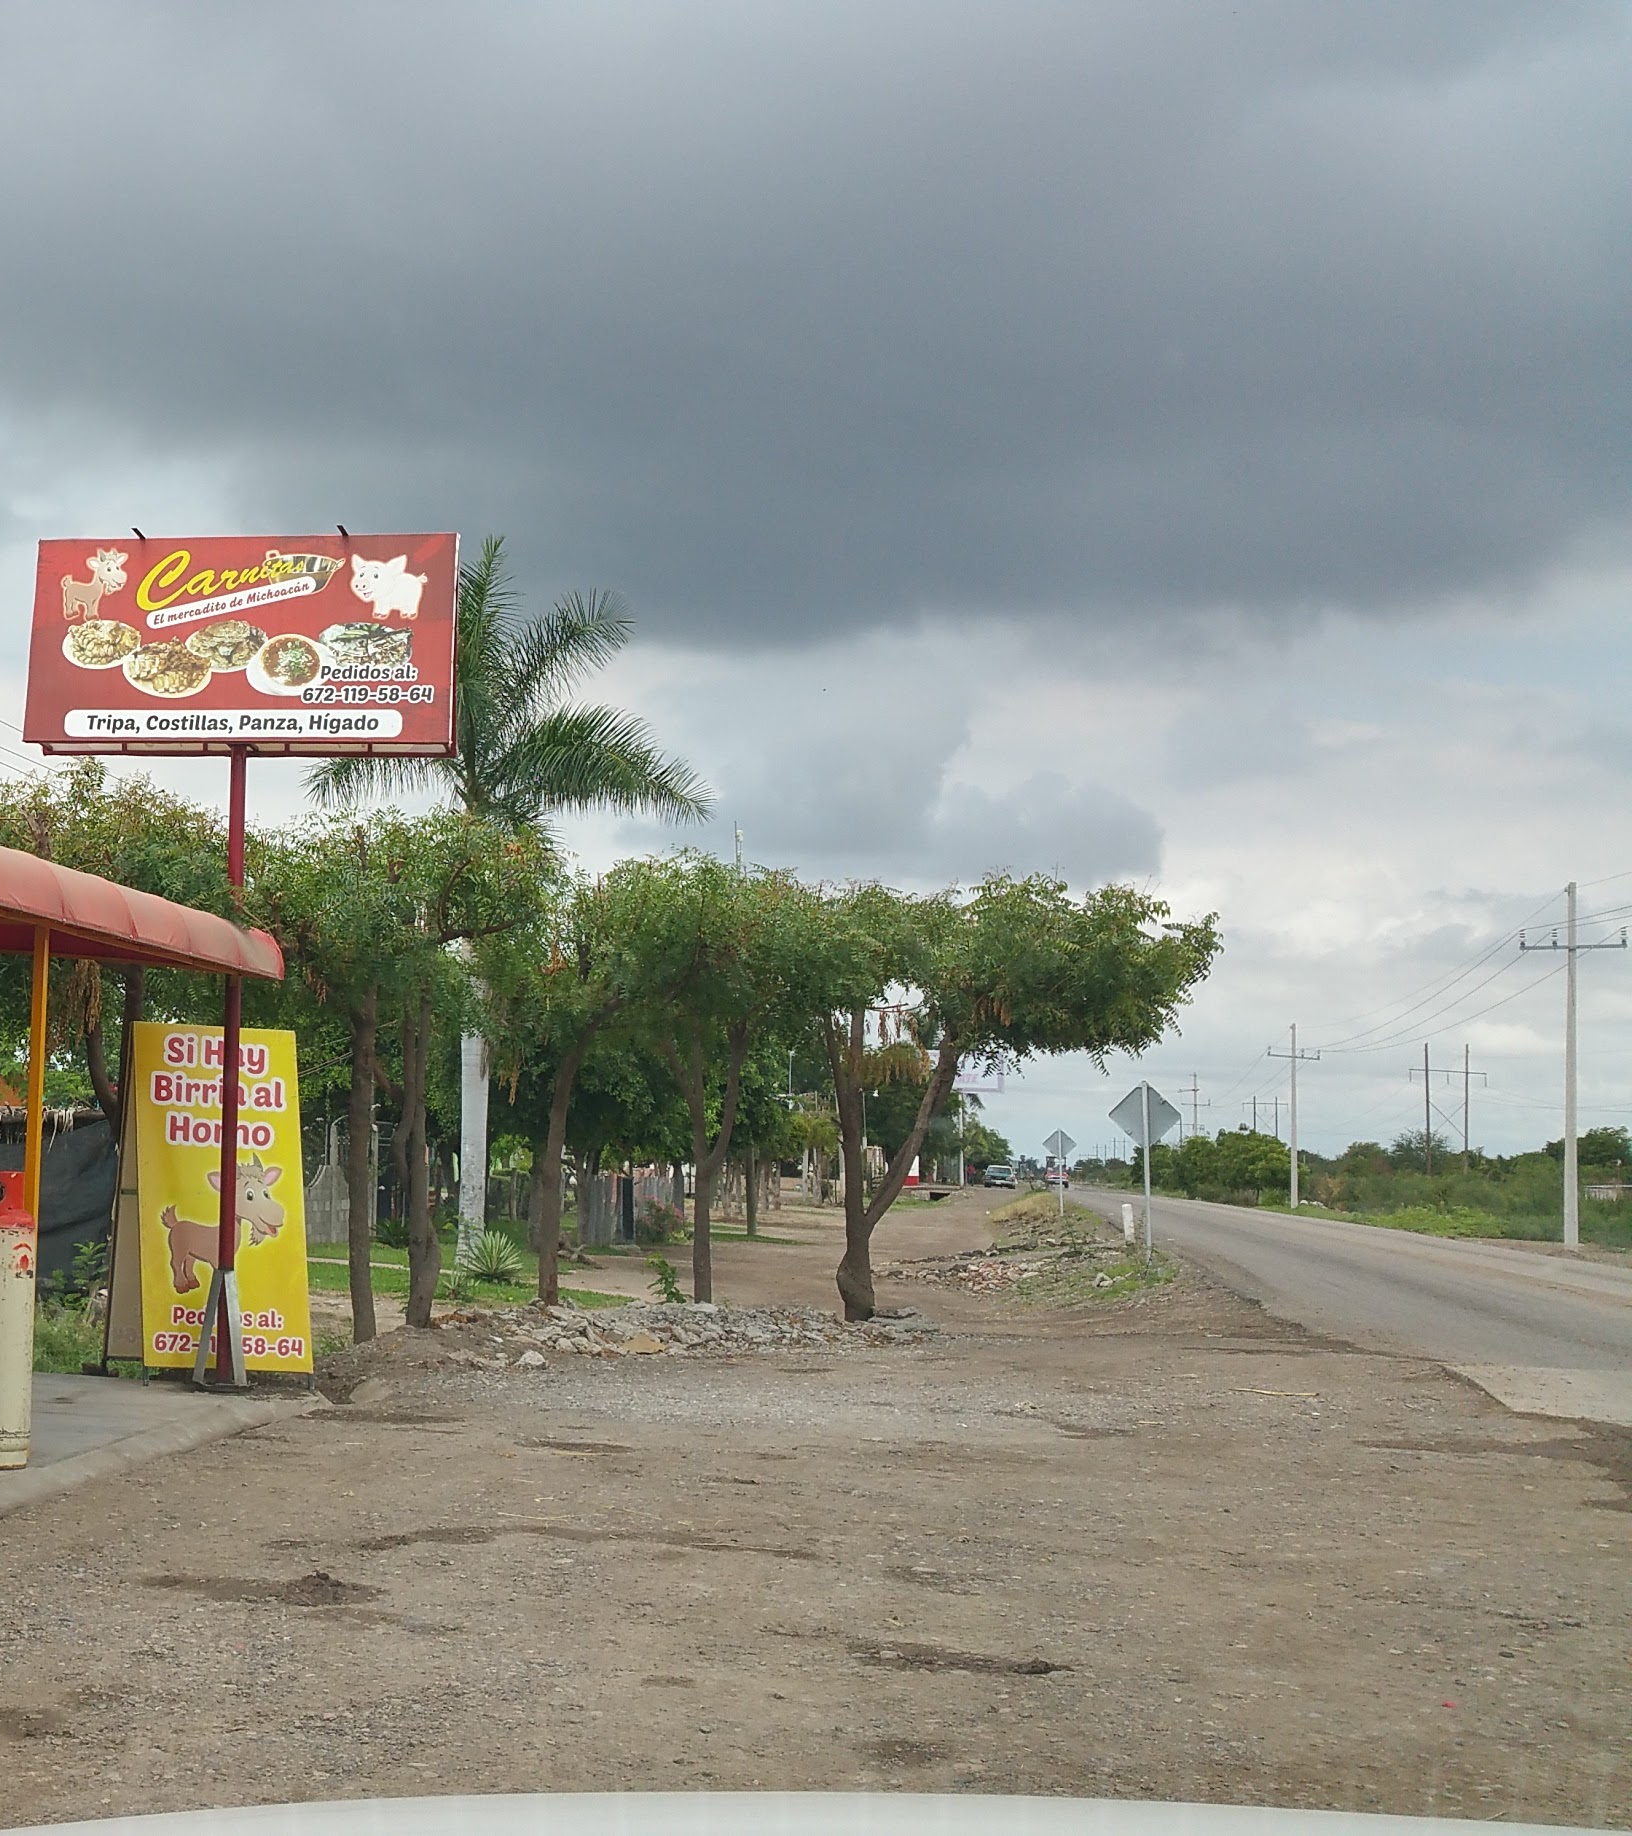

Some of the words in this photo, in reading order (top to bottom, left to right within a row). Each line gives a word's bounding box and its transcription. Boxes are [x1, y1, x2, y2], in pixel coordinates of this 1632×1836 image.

[136, 550, 305, 611] Carnitas
[153, 612, 165, 626] El
[167, 601, 227, 622] mercadito
[229, 595, 243, 608] de
[246, 581, 310, 604] Michoacán
[320, 666, 390, 682] Pedidos
[392, 666, 417, 680] al:
[303, 687, 434, 703] 672-119-58-64
[87, 714, 140, 734] Tripa,
[146, 714, 233, 734] Costillas,
[238, 714, 303, 734] Panza,
[309, 713, 379, 733] Hígado
[168, 1036, 195, 1064] Si
[254, 1081, 283, 1108] al
[258, 1310, 283, 1329] al:
